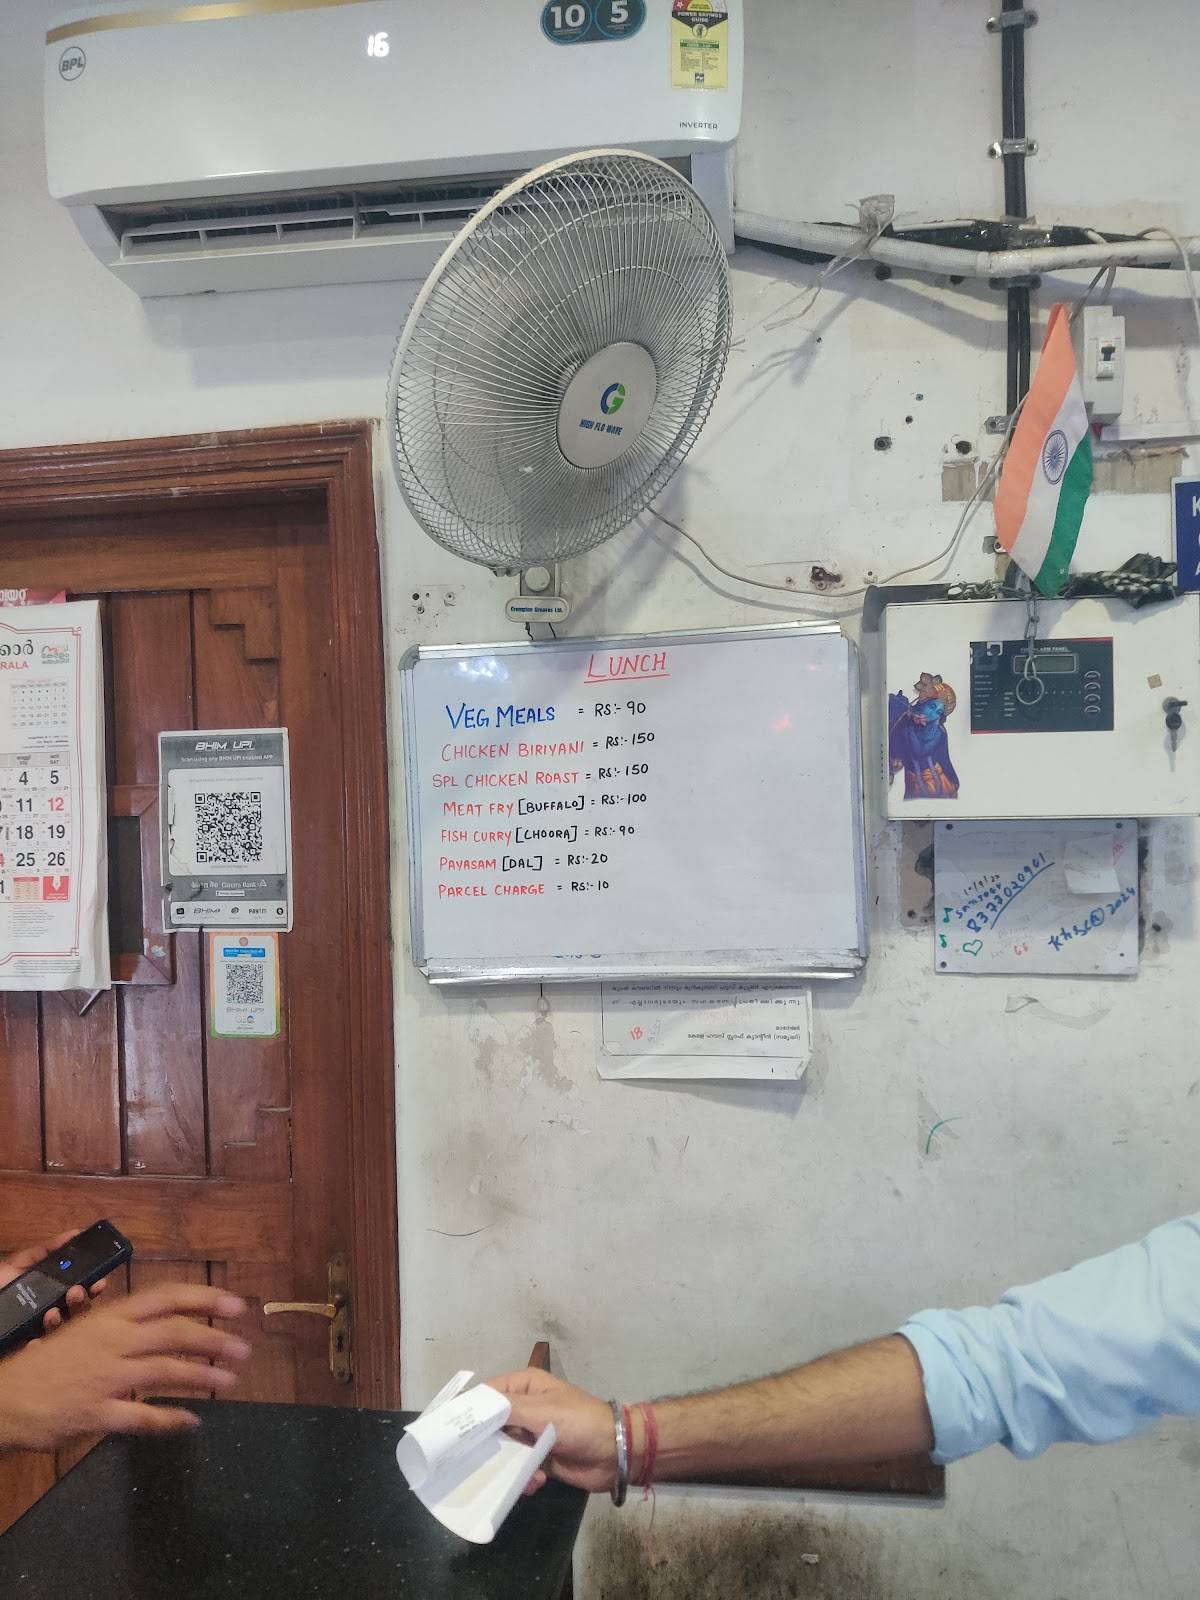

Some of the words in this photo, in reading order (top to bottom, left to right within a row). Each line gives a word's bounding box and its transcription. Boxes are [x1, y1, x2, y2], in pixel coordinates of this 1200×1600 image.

[551, 4, 586, 29] 10
[610, 0, 629, 24] 5
[367, 31, 390, 58] 16
[61, 56, 85, 72] BPL
[679, 121, 718, 130] INVERTER
[579, 418, 595, 429] HIGH
[594, 421, 606, 432] FLO
[588, 652, 667, 679] LUNCH
[446, 702, 490, 729] VEG
[495, 704, 555, 728] MEALS
[195, 741, 228, 752] BHIM
[233, 740, 254, 750] UPI
[441, 742, 509, 762] CHICKEN
[518, 741, 585, 758] BIRIYANI
[19, 771, 29, 785] 4
[50, 770, 59, 785] 5
[432, 774, 459, 789] SPL
[464, 771, 528, 788] CHICKEN
[535, 771, 580, 786] ROAST
[16, 798, 32, 812] 11
[48, 796, 64, 811] 12
[443, 801, 482, 817] MEAT
[489, 802, 514, 818] FRY
[518, 795, 585, 816] [BUFFALO]
[16, 825, 34, 839] 18
[47, 824, 66, 839] 19
[441, 829, 468, 844] FISH
[473, 829, 512, 847] CURRY
[515, 825, 578, 844] [CHOORA]
[16, 853, 35, 867] 25
[47, 852, 66, 866] 26
[439, 856, 497, 871] PAYASAM
[502, 855, 543, 872] [DAL]
[438, 884, 488, 900] PARCEL
[494, 883, 545, 897] CHARGE
